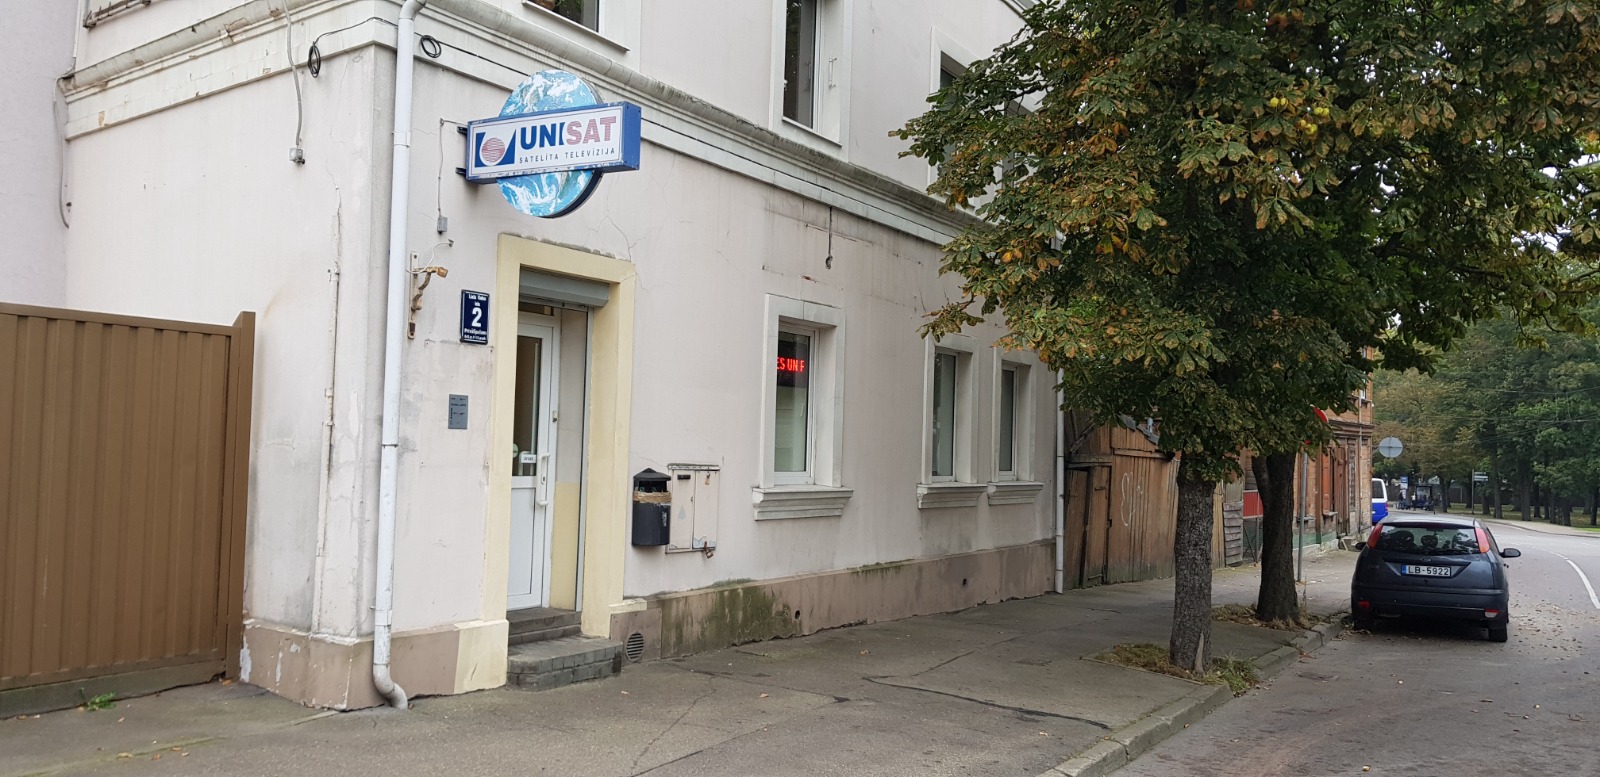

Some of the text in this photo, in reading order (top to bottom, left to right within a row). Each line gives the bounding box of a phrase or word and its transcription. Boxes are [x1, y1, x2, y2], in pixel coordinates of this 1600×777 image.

[520, 116, 617, 150] UNISAT
[519, 147, 615, 164] SATELĪTA TELEVĪZIJA
[471, 307, 482, 328] 2
[787, 358, 798, 371] UN
[1408, 565, 1449, 576] LB-5922
